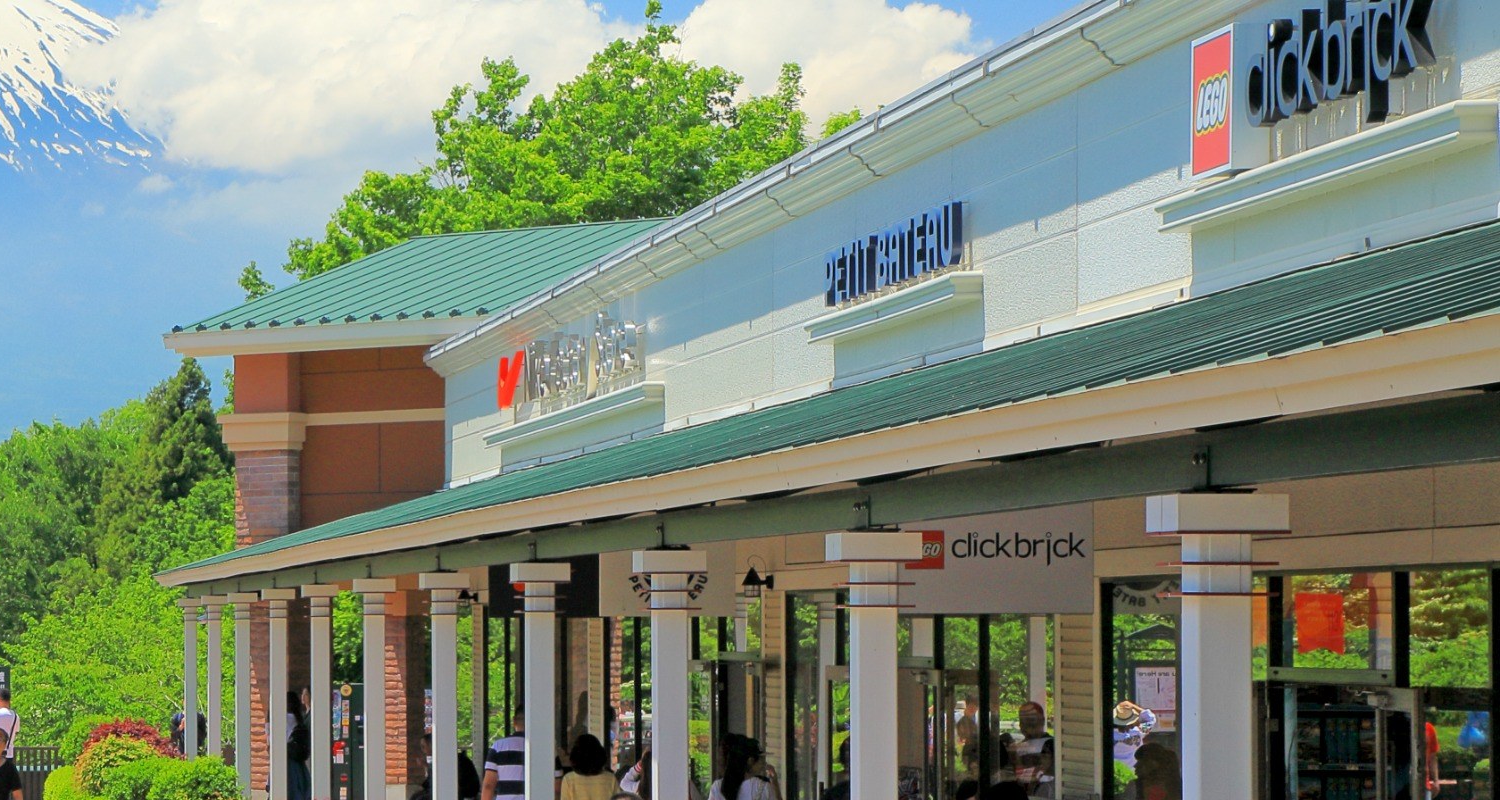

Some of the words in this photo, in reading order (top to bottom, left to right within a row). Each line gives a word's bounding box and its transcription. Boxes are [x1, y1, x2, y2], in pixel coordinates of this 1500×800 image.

[1196, 72, 1228, 135] LEGO
[825, 236, 877, 306] PETIT
[877, 202, 962, 287] BATEAU
[922, 542, 942, 558] GO
[628, 574, 652, 602] PETI
